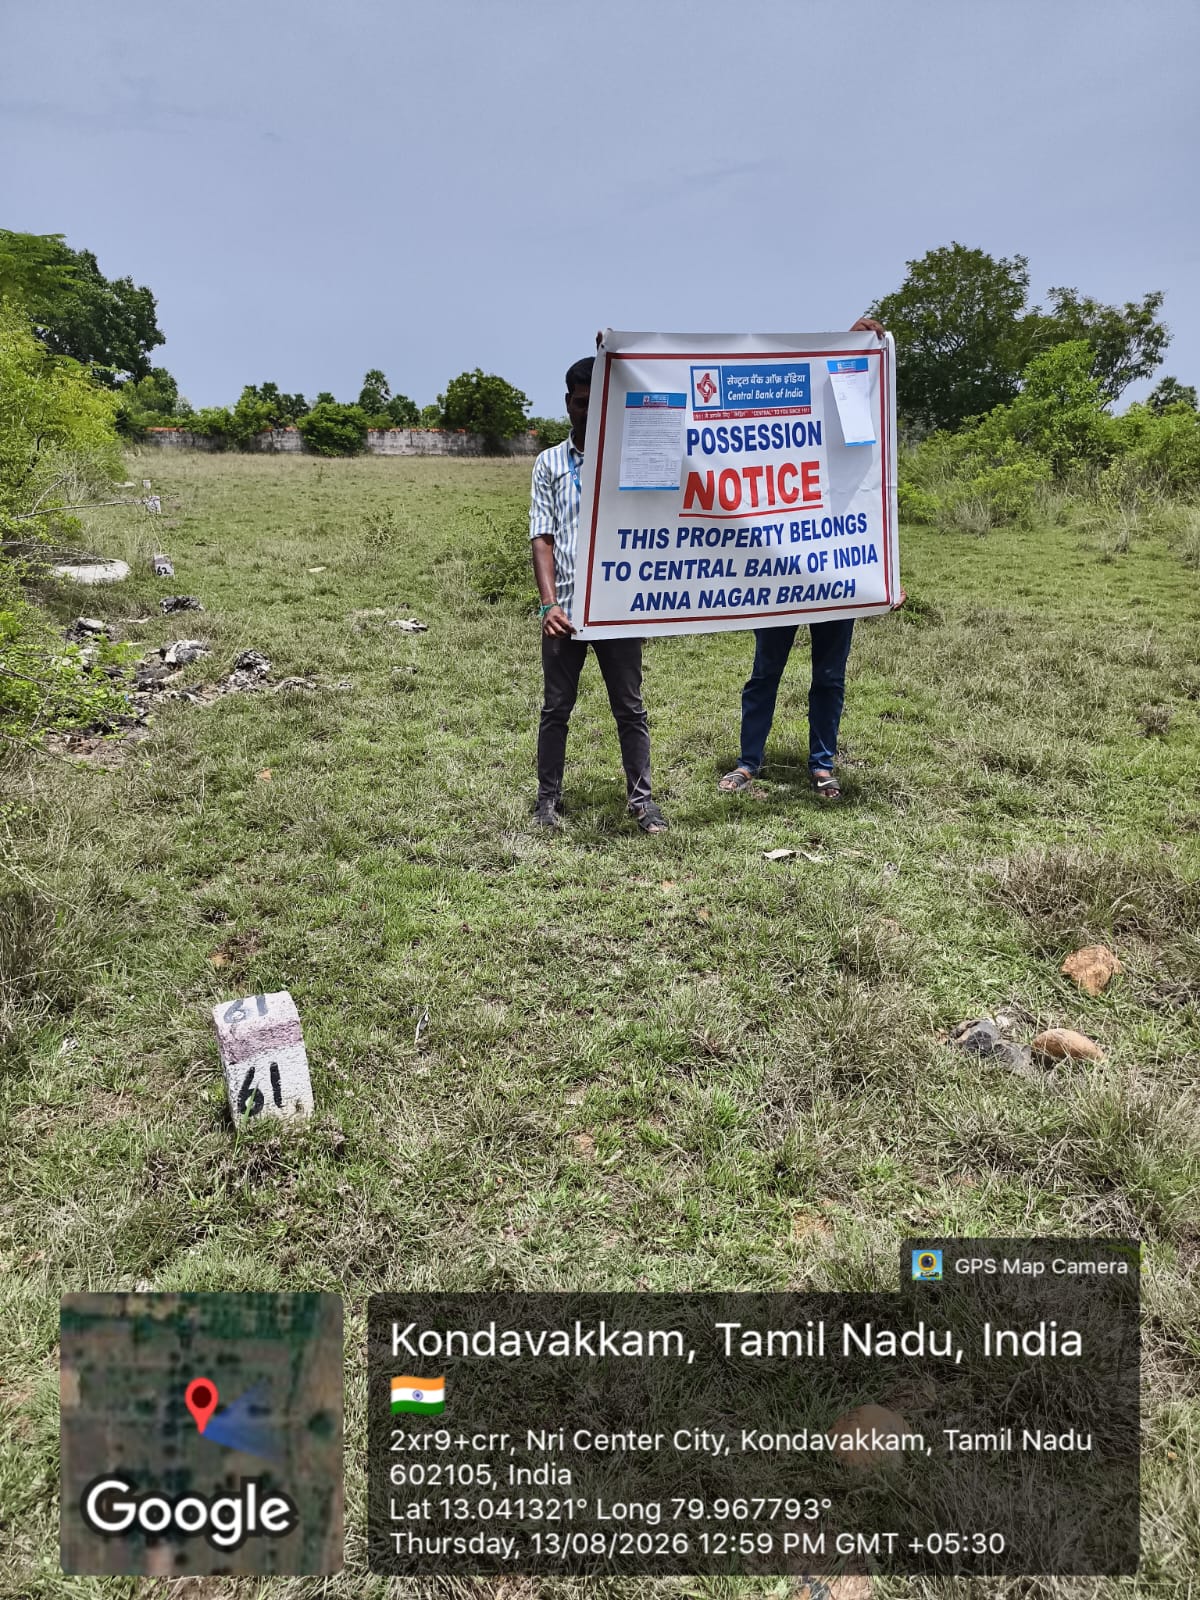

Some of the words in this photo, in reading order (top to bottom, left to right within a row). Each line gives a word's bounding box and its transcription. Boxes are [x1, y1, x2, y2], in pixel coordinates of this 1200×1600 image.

[727, 389, 754, 401] Central
[755, 388, 774, 399] Bank
[775, 387, 784, 399] of
[784, 386, 804, 398] India
[750, 373, 764, 384] बैंक
[686, 420, 822, 456] POSSESSION
[683, 460, 822, 511] NOTICE
[617, 527, 670, 549] THIS
[676, 523, 784, 549] PROPERTY
[790, 512, 868, 543] BELONGS
[156, 565, 170, 576] 62
[601, 561, 632, 582] TO
[638, 558, 737, 581] CENTRAL
[744, 554, 802, 577] BANK
[807, 550, 828, 573] OF
[833, 543, 878, 569] INDIA
[630, 590, 691, 612] ANNA
[698, 587, 771, 609] NAGAR
[775, 578, 856, 605] BRANCH
[237, 1062, 283, 1117] 61
